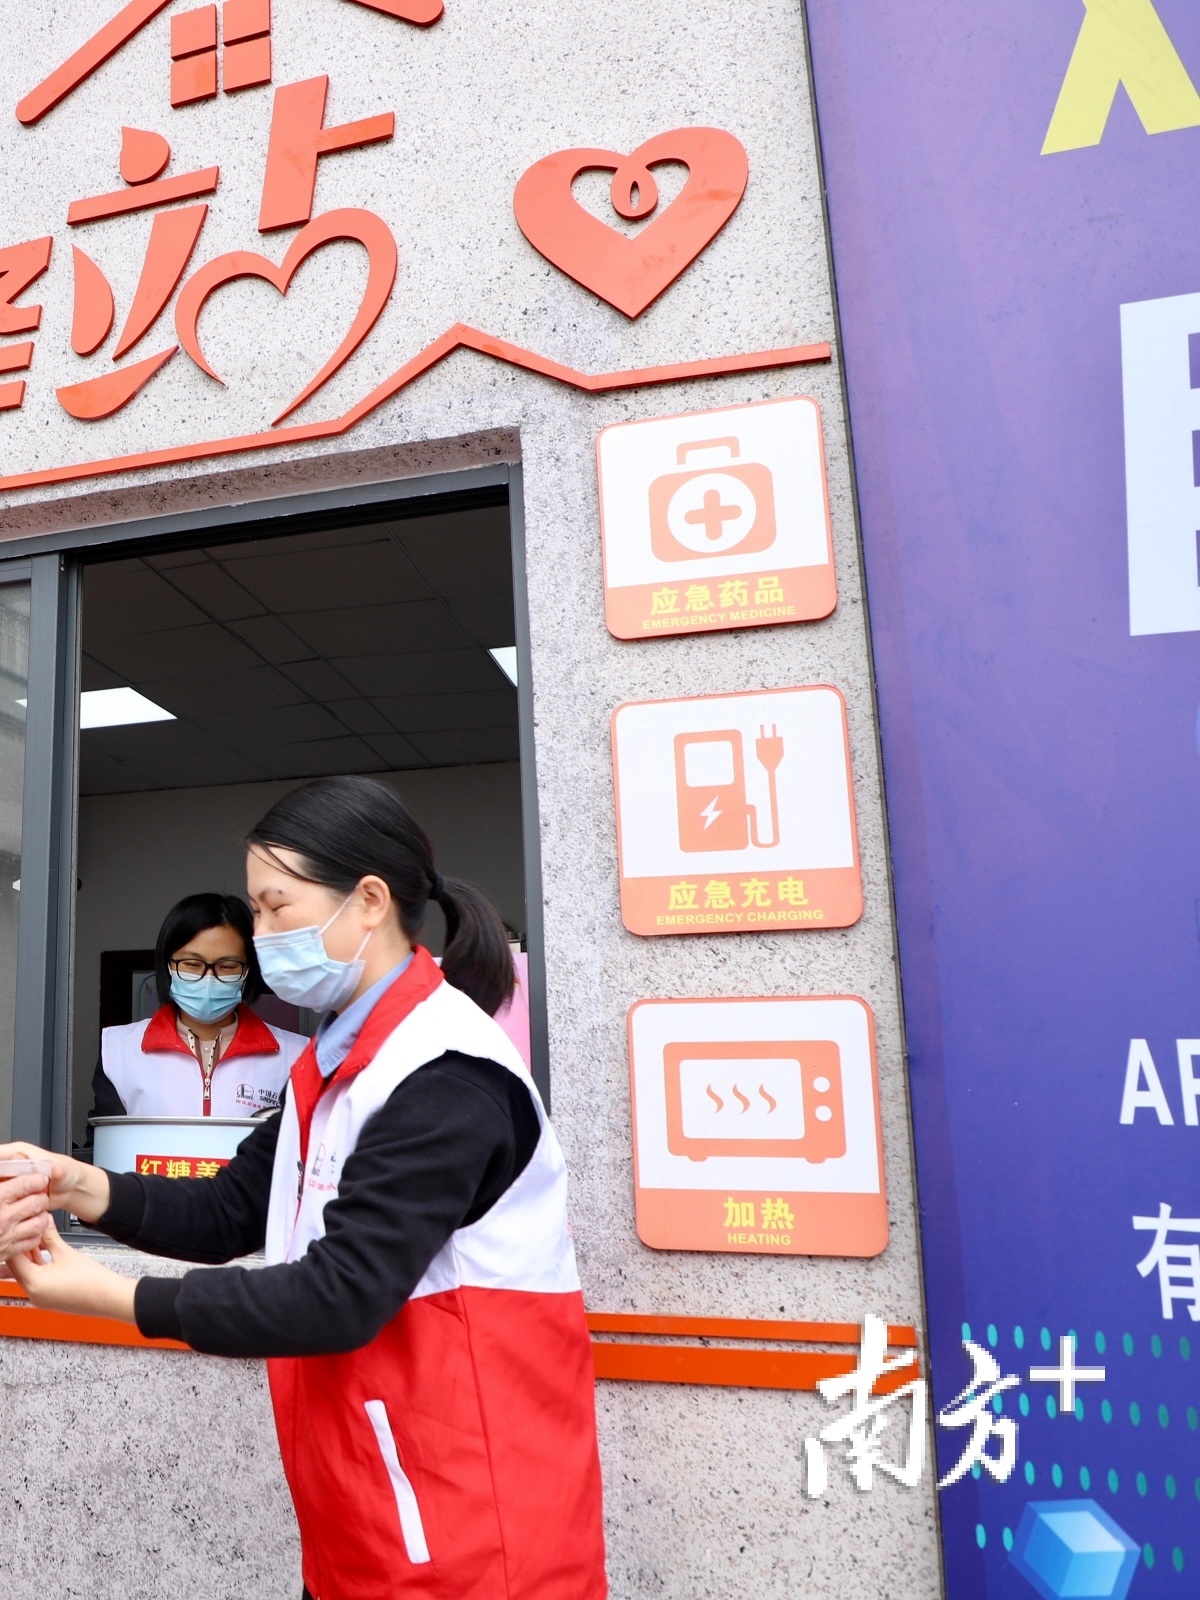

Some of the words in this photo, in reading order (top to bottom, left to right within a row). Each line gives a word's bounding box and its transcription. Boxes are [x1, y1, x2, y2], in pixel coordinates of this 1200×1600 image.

[650, 576, 784, 615] 应急药品
[642, 612, 727, 630] EMERGENCY
[729, 605, 796, 621] MEDICINE
[667, 876, 810, 911] 应急充电
[656, 912, 745, 926] EMERGENCY
[747, 909, 824, 922] CHARGING
[723, 1196, 794, 1230] 加热
[727, 1233, 792, 1246] HEATING
